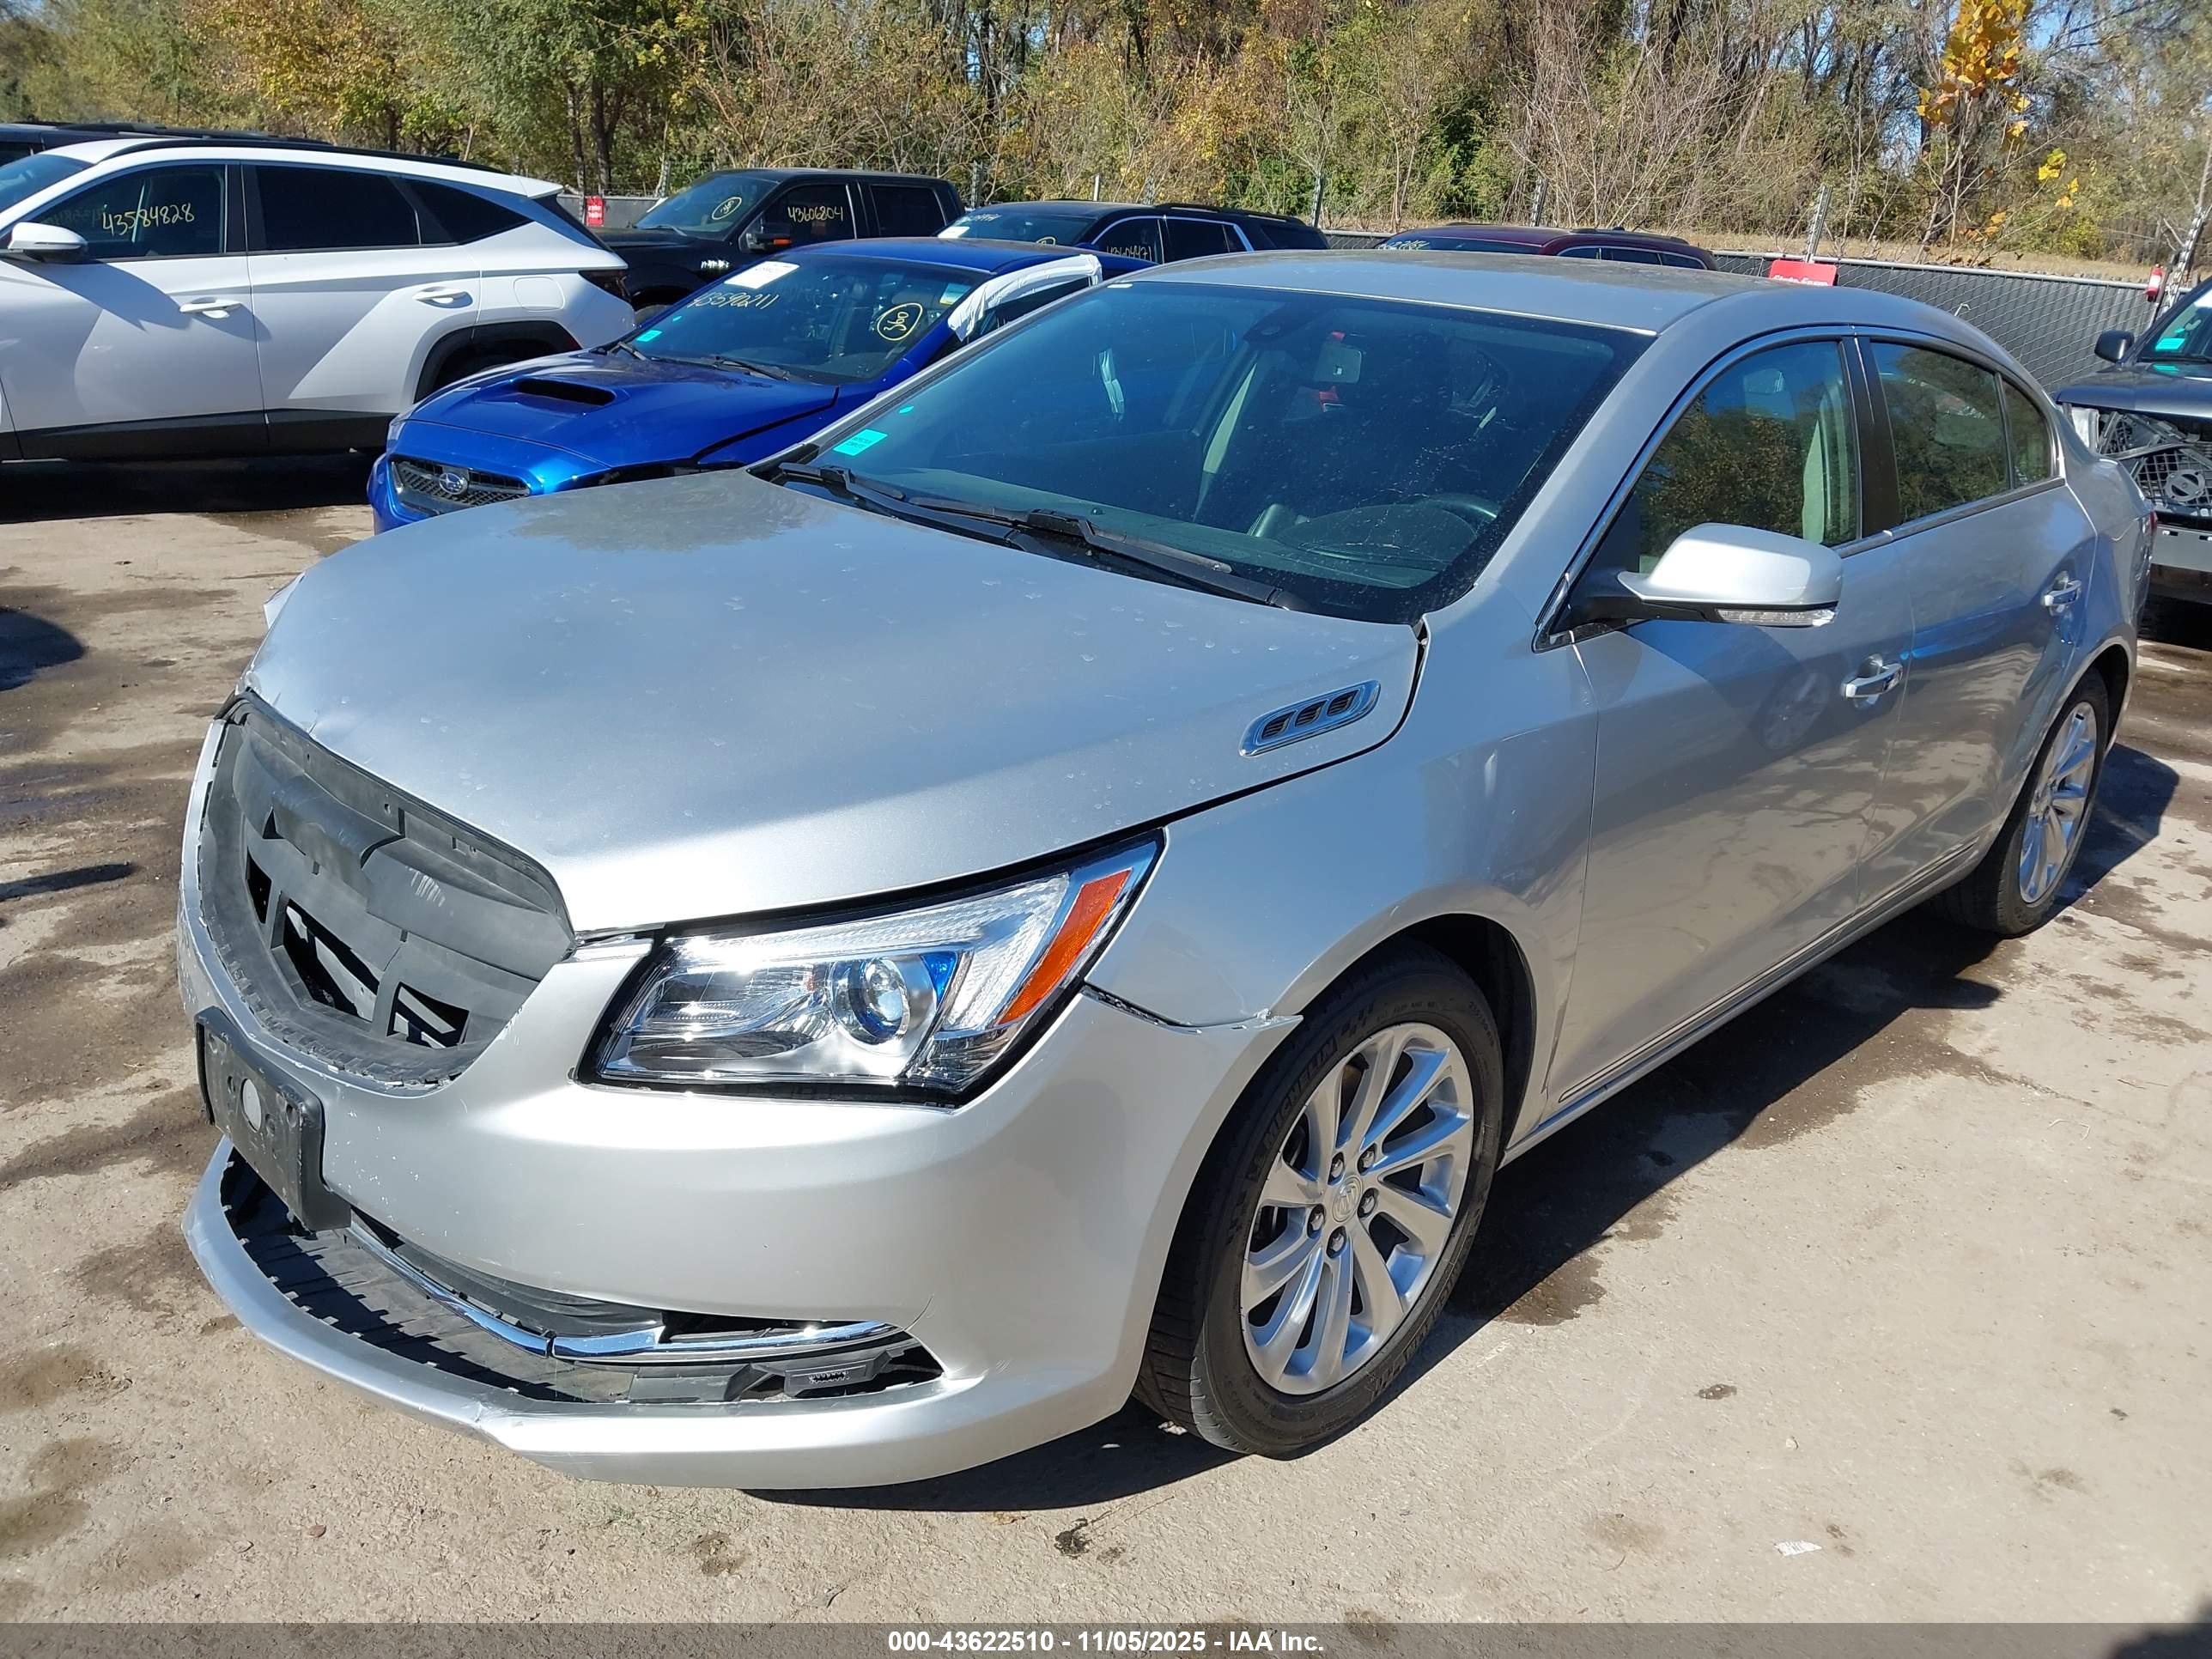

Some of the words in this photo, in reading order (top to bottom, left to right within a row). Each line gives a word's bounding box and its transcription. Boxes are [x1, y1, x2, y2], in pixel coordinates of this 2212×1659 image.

[101, 203, 195, 236] 43584828
[787, 205, 844, 222] 43606804
[1263, 1036, 1339, 1148] MICHELIN
